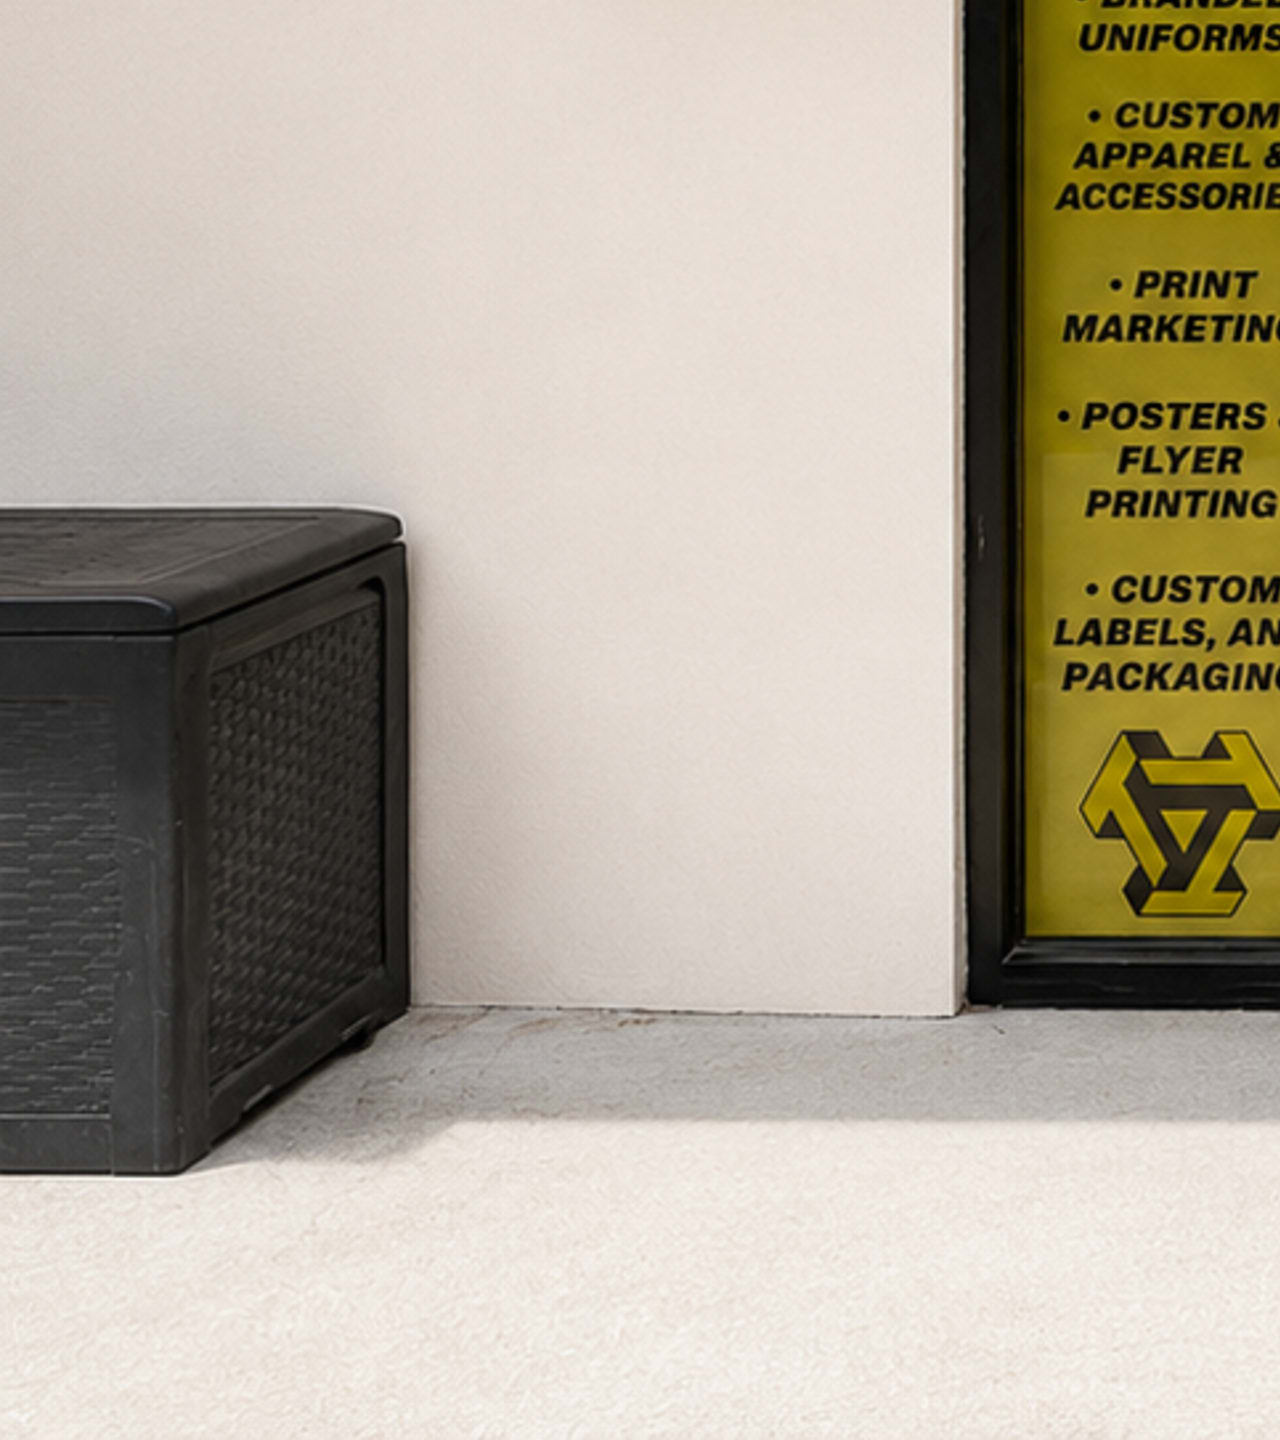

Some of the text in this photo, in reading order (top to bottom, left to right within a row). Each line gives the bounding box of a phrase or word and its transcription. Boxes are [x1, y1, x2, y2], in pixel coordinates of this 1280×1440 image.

[1073, 142, 1251, 170] APPAREL
[1134, 270, 1259, 299] PRINT
[1081, 401, 1267, 431] POSTERS
[1117, 445, 1244, 475] FLYER
[1085, 489, 1277, 518] PRINTING
[1053, 617, 1216, 652] LABELS,
